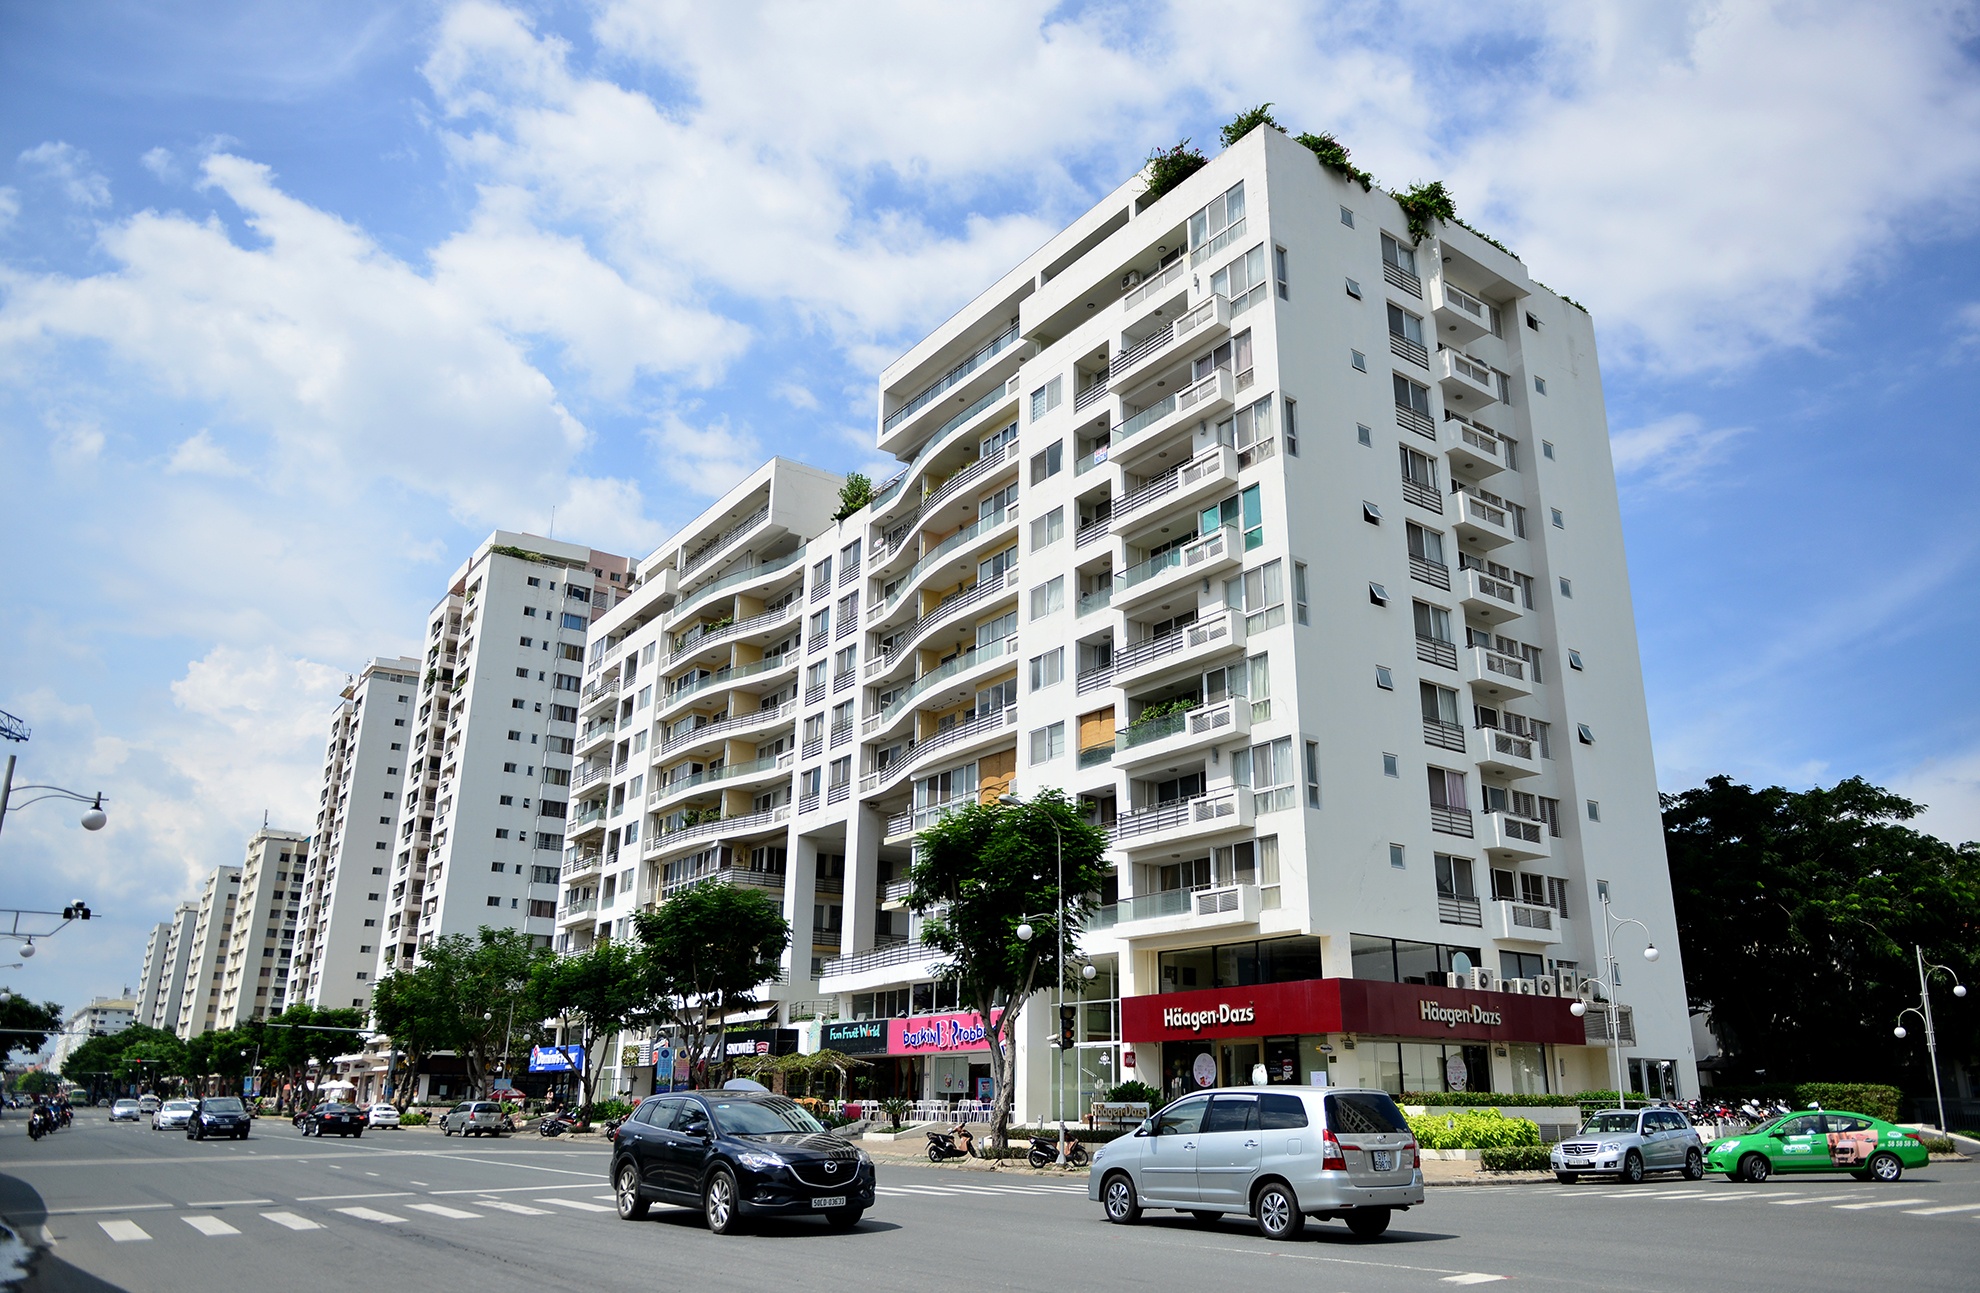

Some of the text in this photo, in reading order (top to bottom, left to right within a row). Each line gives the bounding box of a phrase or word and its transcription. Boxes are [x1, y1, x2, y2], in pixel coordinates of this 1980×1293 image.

[829, 1023, 880, 1040] Fun Fruit World
